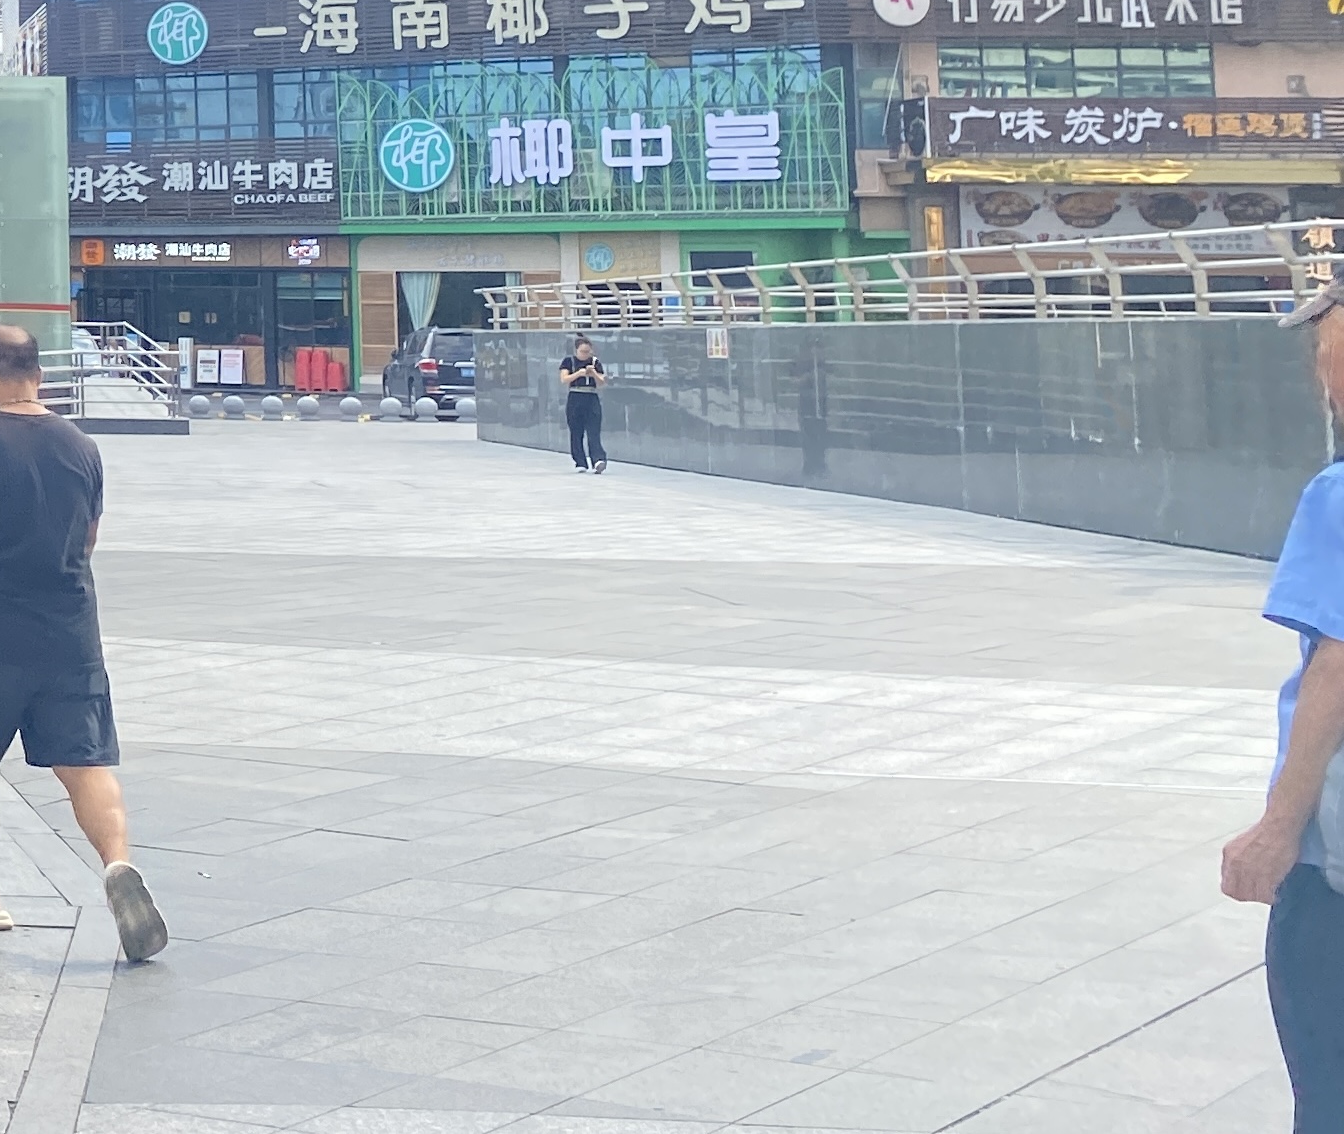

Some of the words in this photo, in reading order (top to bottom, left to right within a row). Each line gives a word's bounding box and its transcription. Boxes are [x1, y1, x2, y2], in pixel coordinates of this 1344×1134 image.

[487, 108, 782, 187] 椰中皇
[162, 159, 334, 192] 潮汕牛肉店
[234, 193, 295, 205] CHAOFA
[298, 192, 335, 204] BEEF
